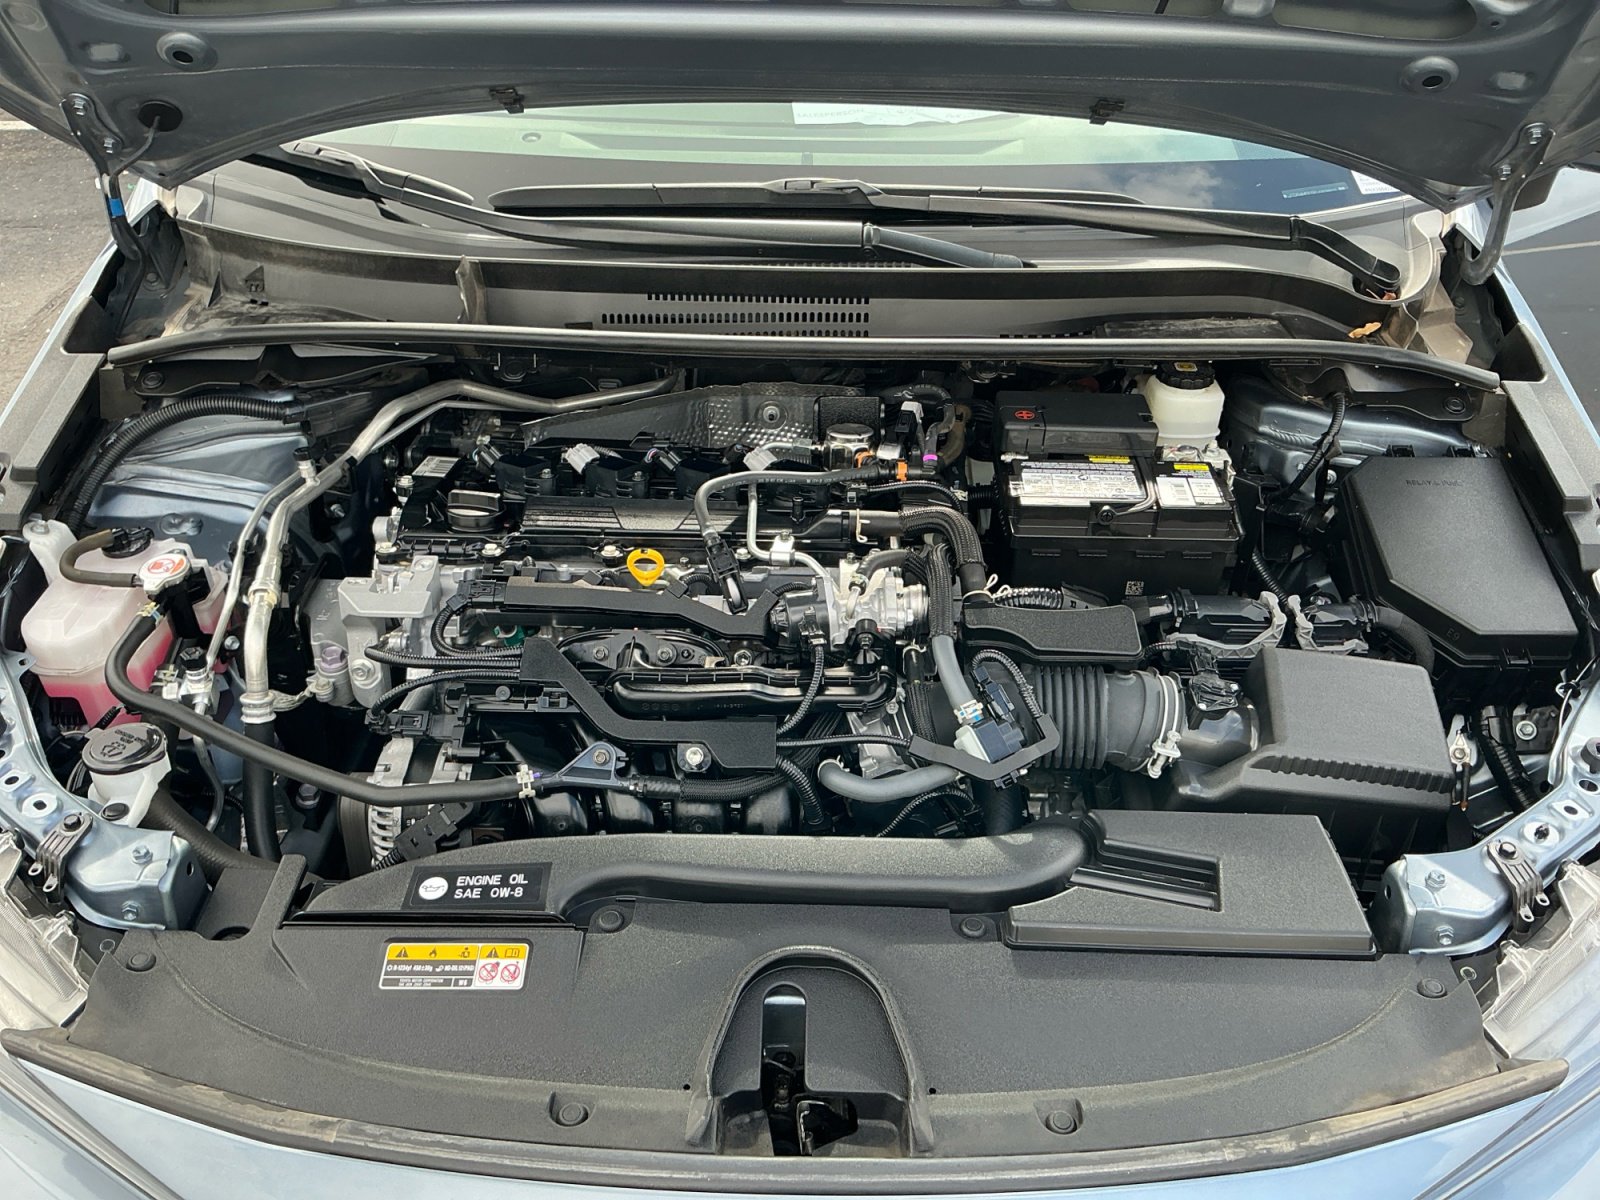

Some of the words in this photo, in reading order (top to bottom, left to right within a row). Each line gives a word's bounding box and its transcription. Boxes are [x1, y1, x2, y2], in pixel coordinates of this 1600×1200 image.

[456, 874, 502, 887] ENGINE
[509, 873, 529, 885] OIL
[453, 887, 482, 899] SAE
[490, 886, 523, 898] 0W-8
